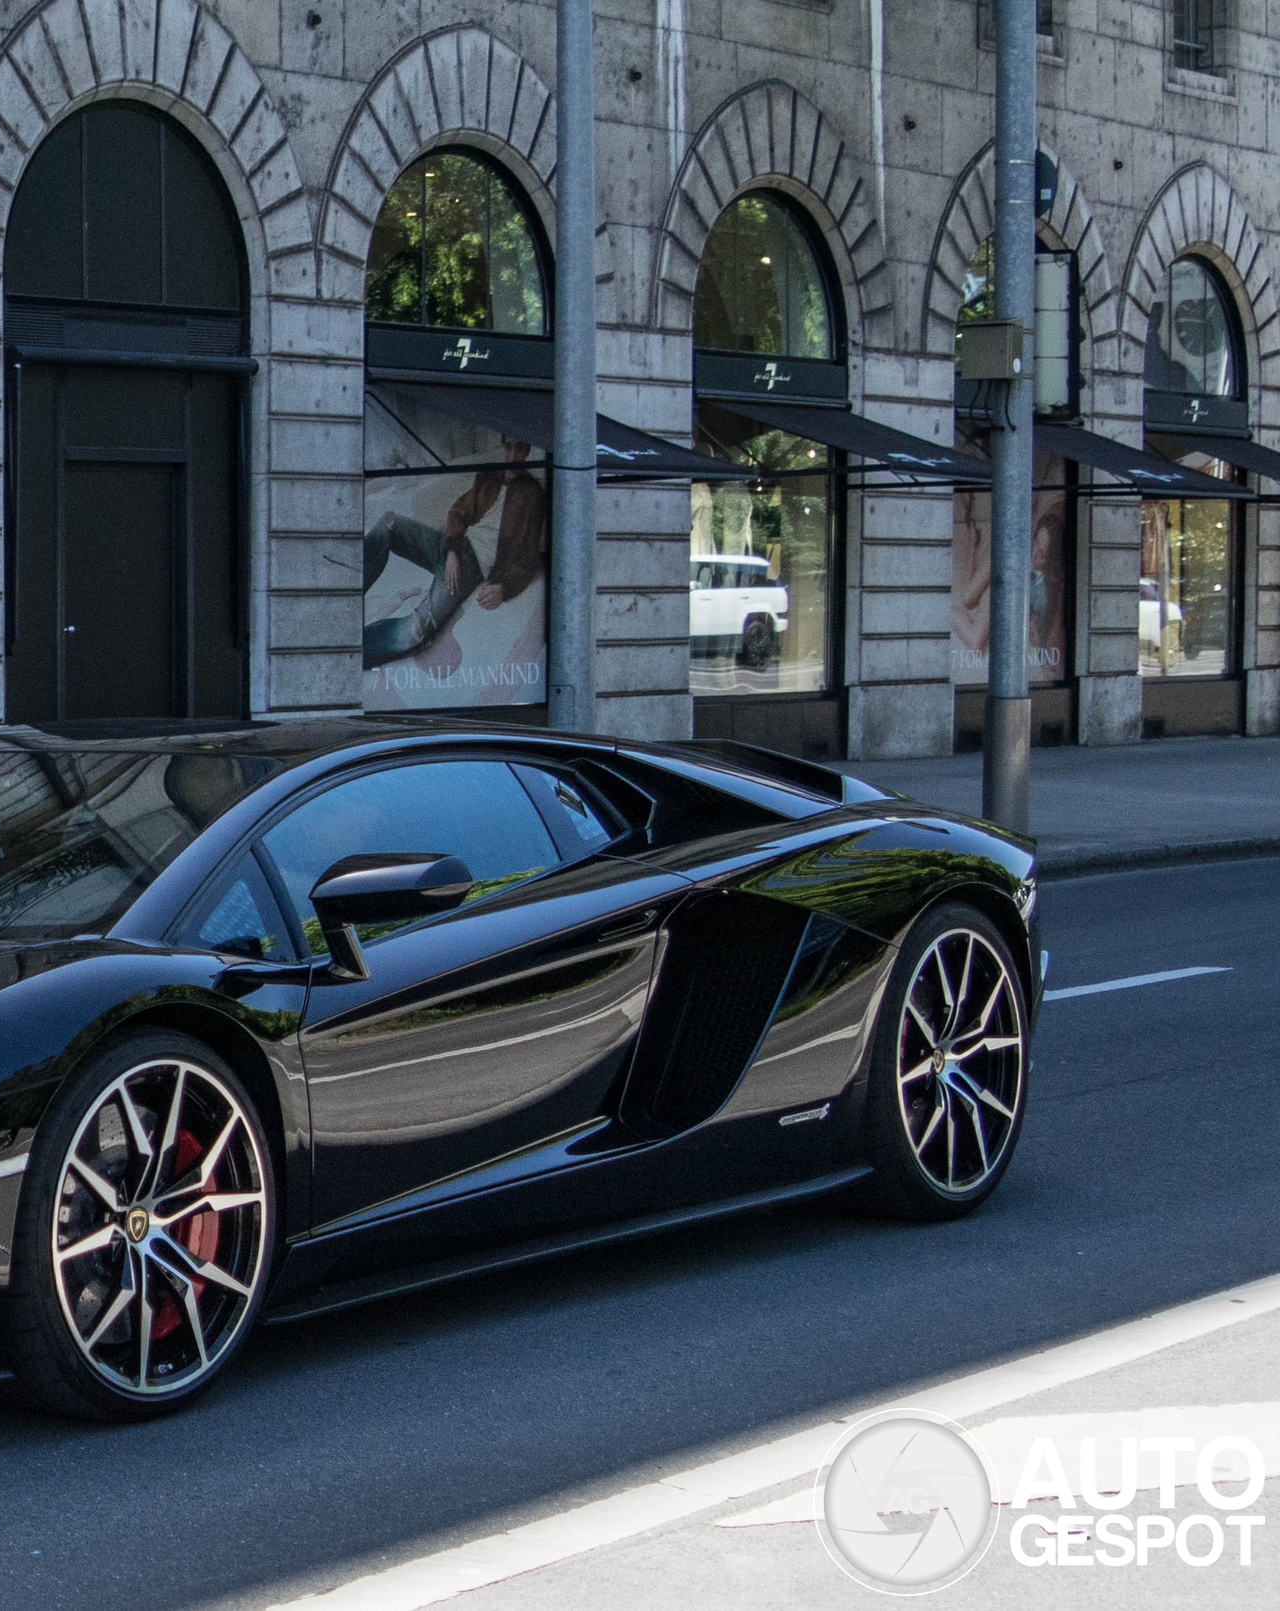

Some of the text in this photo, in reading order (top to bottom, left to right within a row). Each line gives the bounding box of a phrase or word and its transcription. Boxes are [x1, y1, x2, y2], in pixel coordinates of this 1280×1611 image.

[384, 665, 421, 691] FOR
[424, 665, 455, 689] ALL
[460, 662, 540, 688] MANKIND
